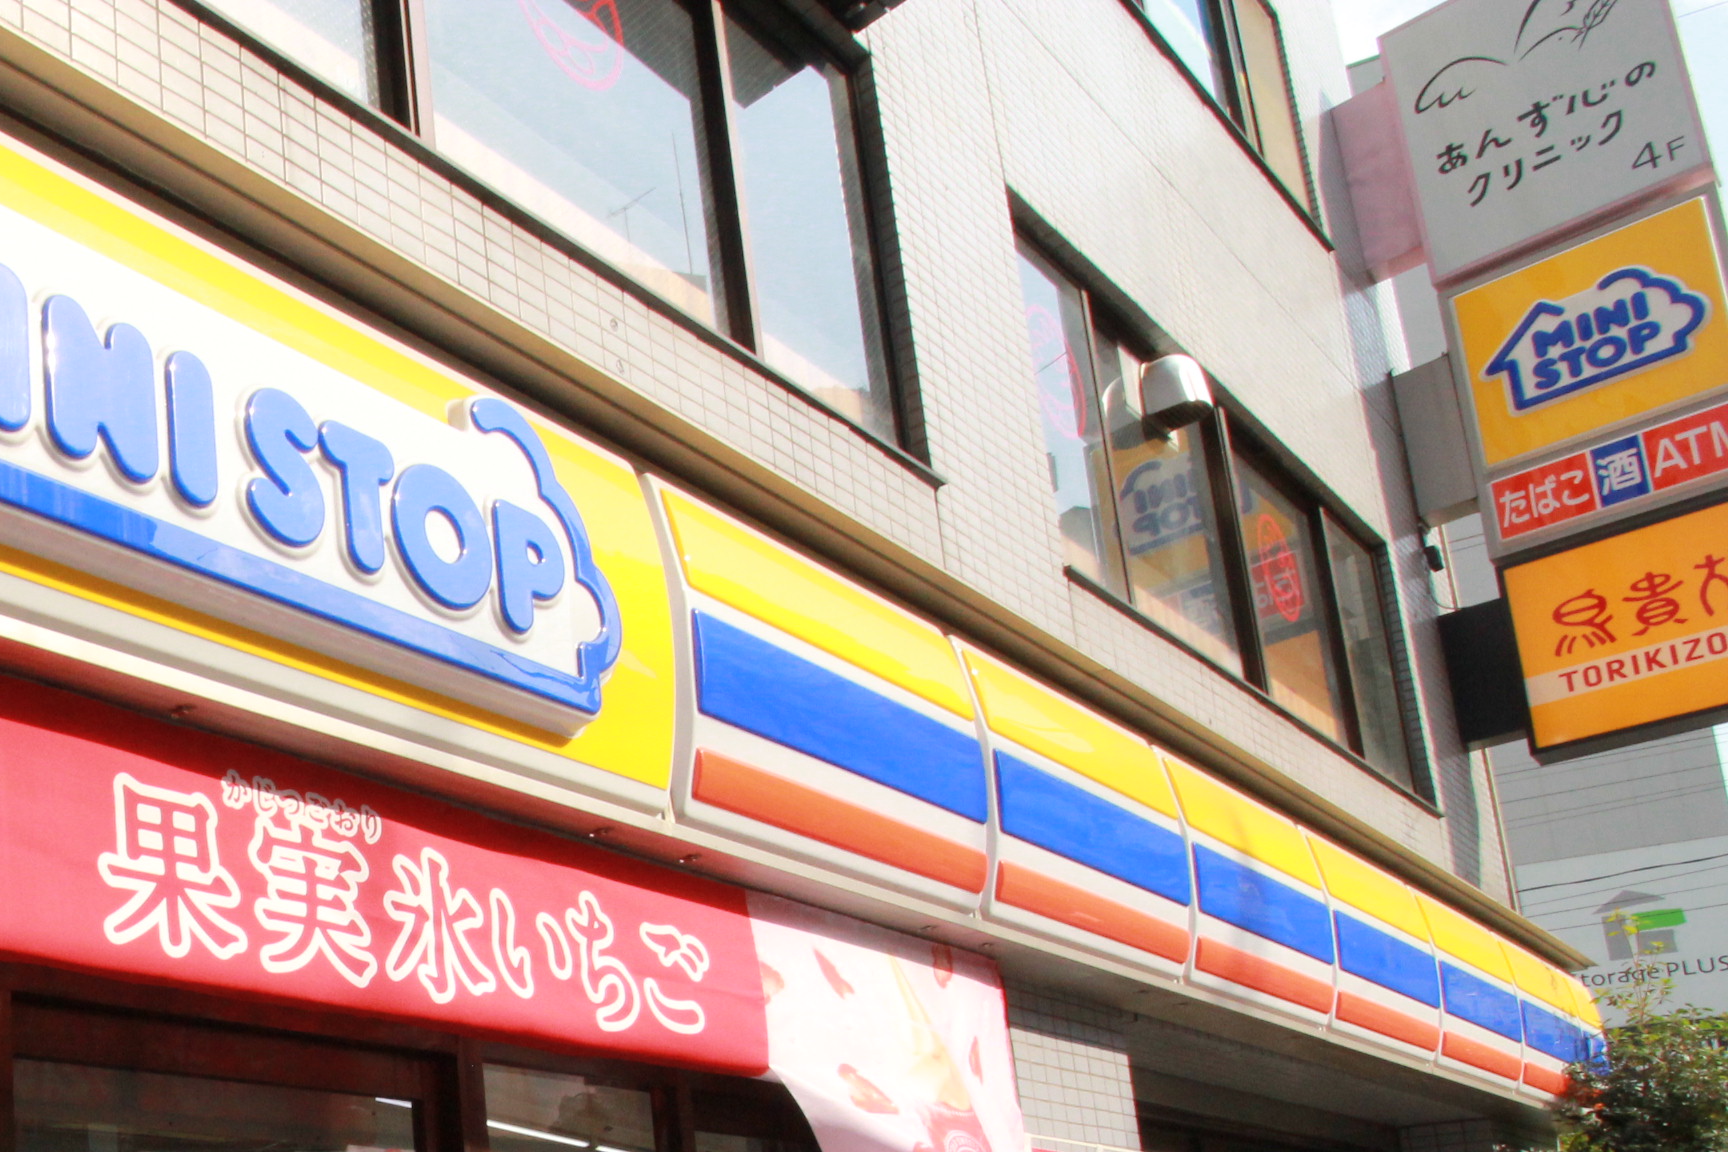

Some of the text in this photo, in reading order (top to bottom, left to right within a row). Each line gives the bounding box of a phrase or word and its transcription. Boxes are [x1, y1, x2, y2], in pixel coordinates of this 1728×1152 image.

[1467, 110, 1624, 207] クリニック
[1631, 136, 1686, 171] 4F
[1533, 291, 1651, 357] MINI
[1533, 322, 1662, 390] STOP
[1499, 469, 1591, 528] たばこ
[1595, 447, 1641, 496] 酒
[221, 768, 382, 843] かじつごおり
[97, 772, 709, 1034] 果実氷いちご
[1574, 963, 1660, 988] torage
